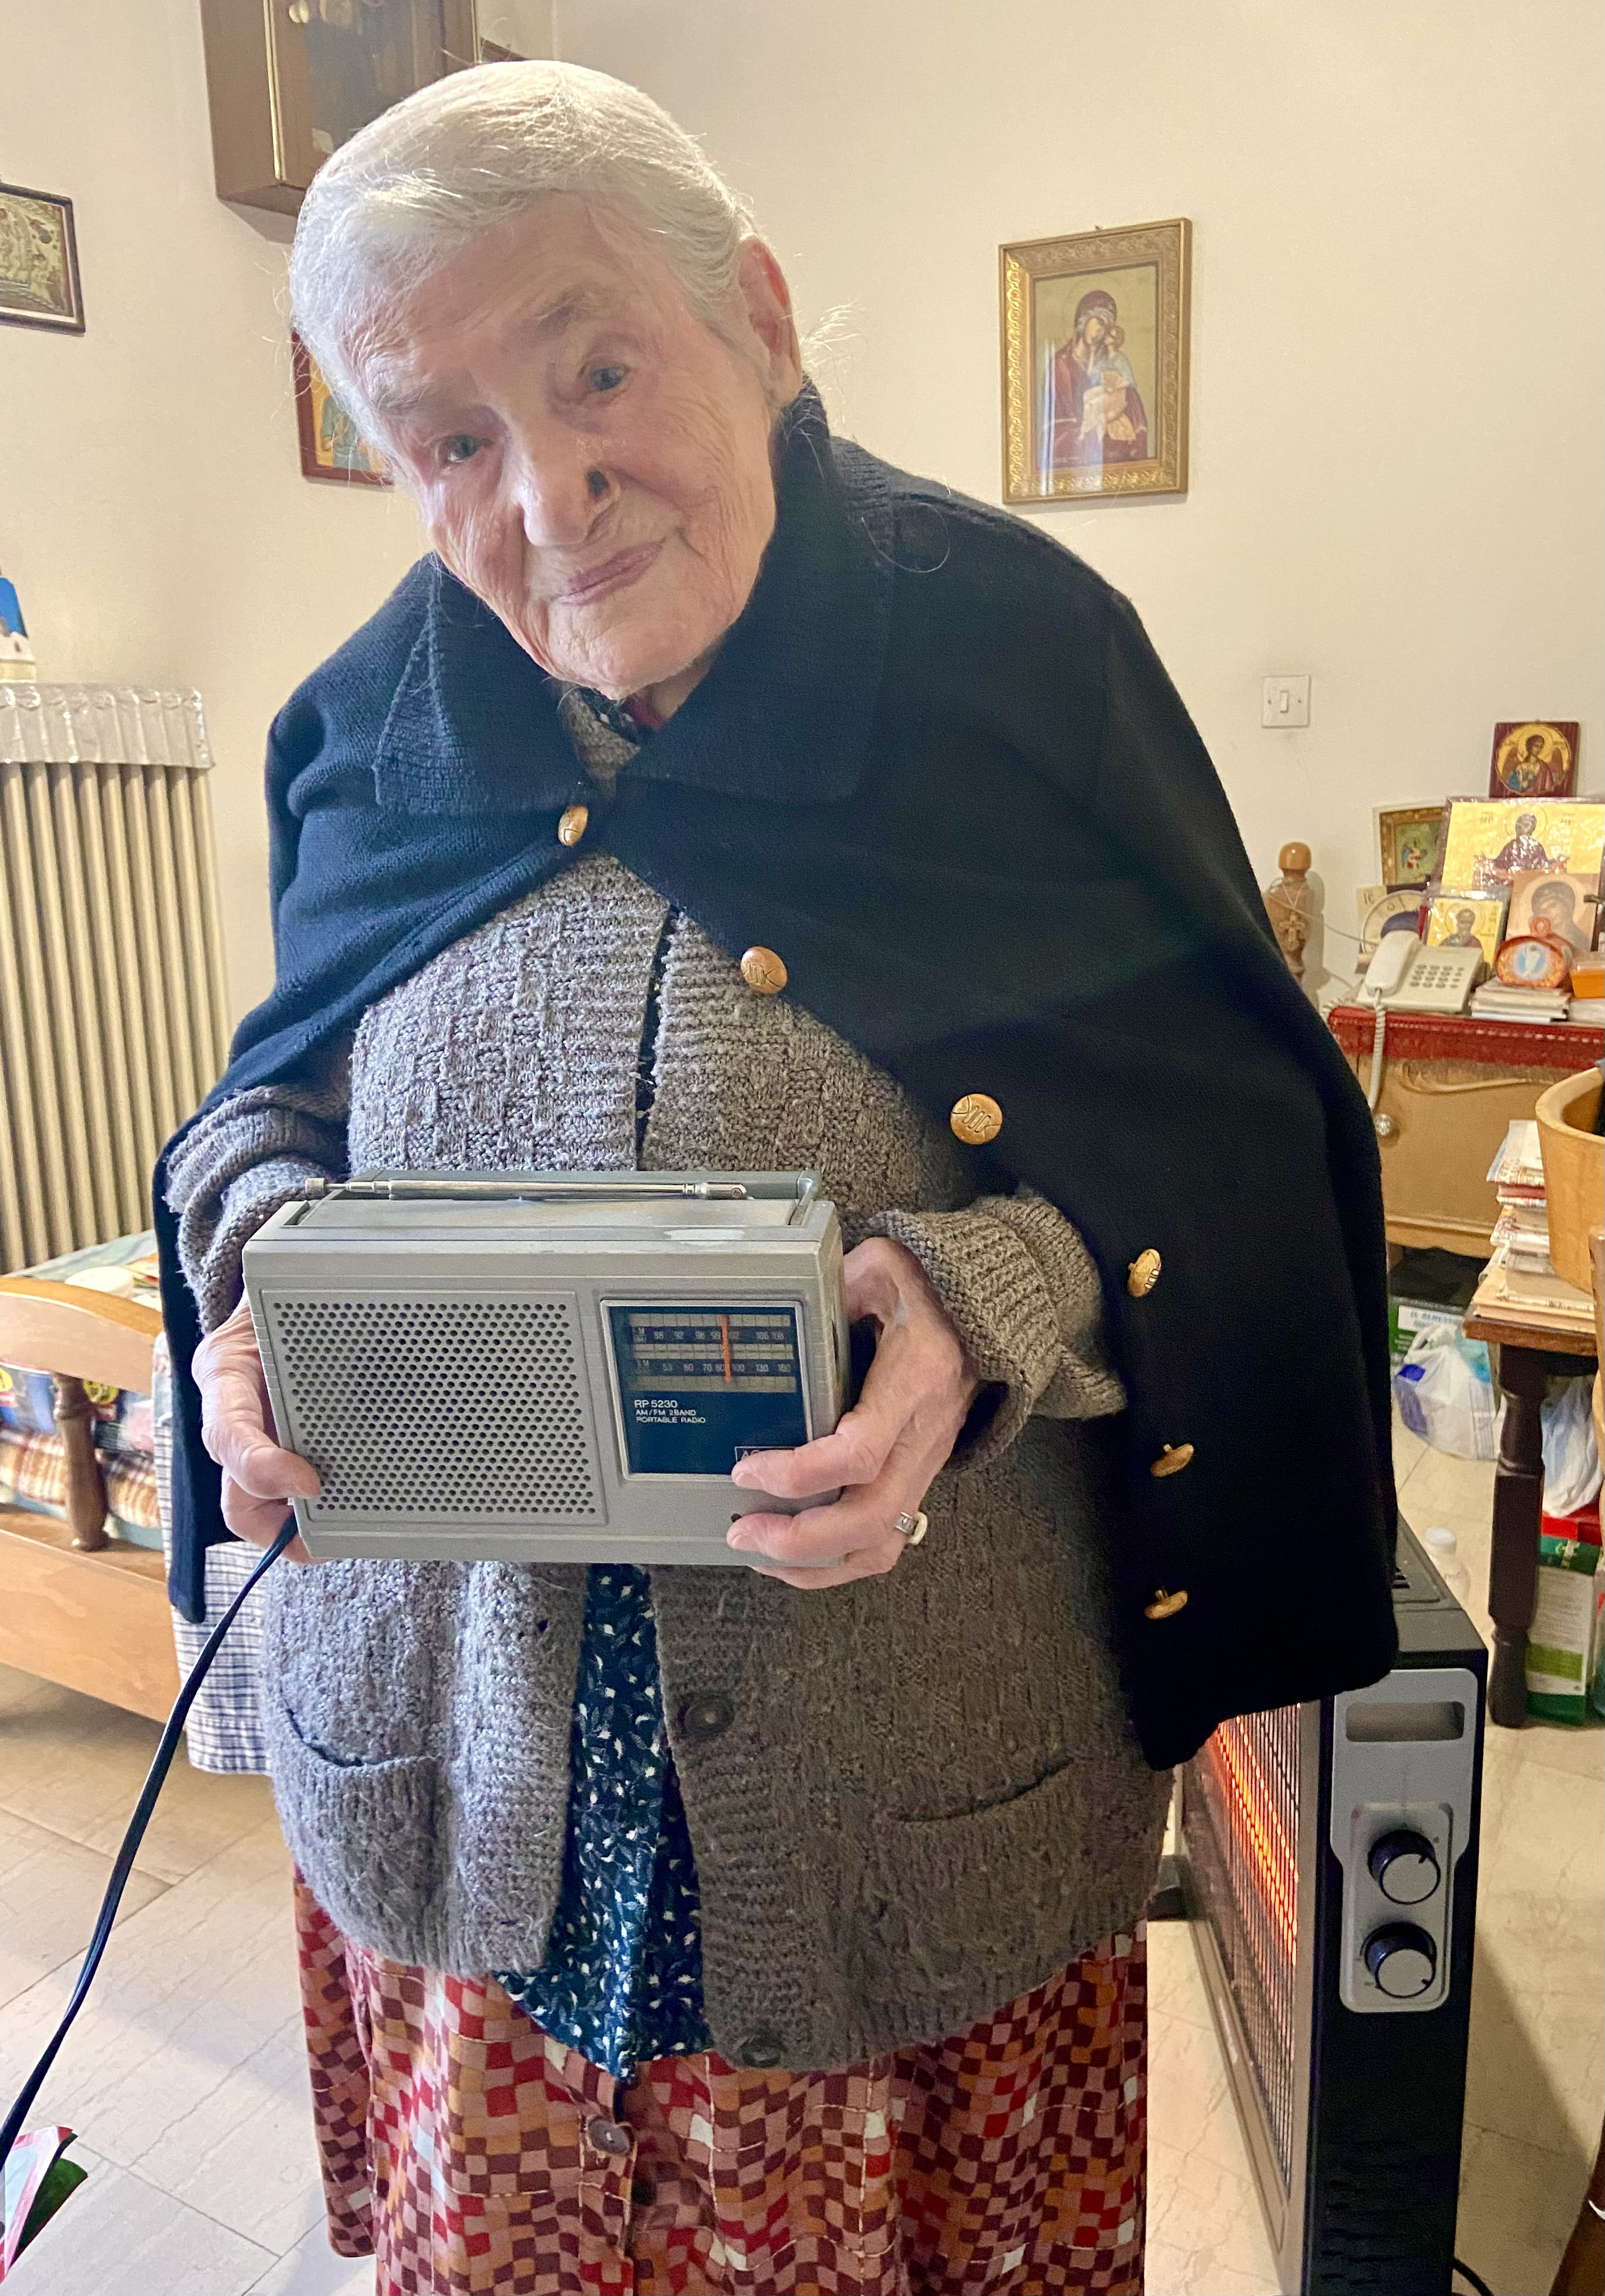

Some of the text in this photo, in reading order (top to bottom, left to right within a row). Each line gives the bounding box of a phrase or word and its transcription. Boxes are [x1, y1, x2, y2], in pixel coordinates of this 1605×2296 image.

[674, 1331, 684, 1339] 92
[702, 1363, 713, 1372] 70
[755, 1364, 769, 1372] 130
[634, 1399, 678, 1408] RP 5230
